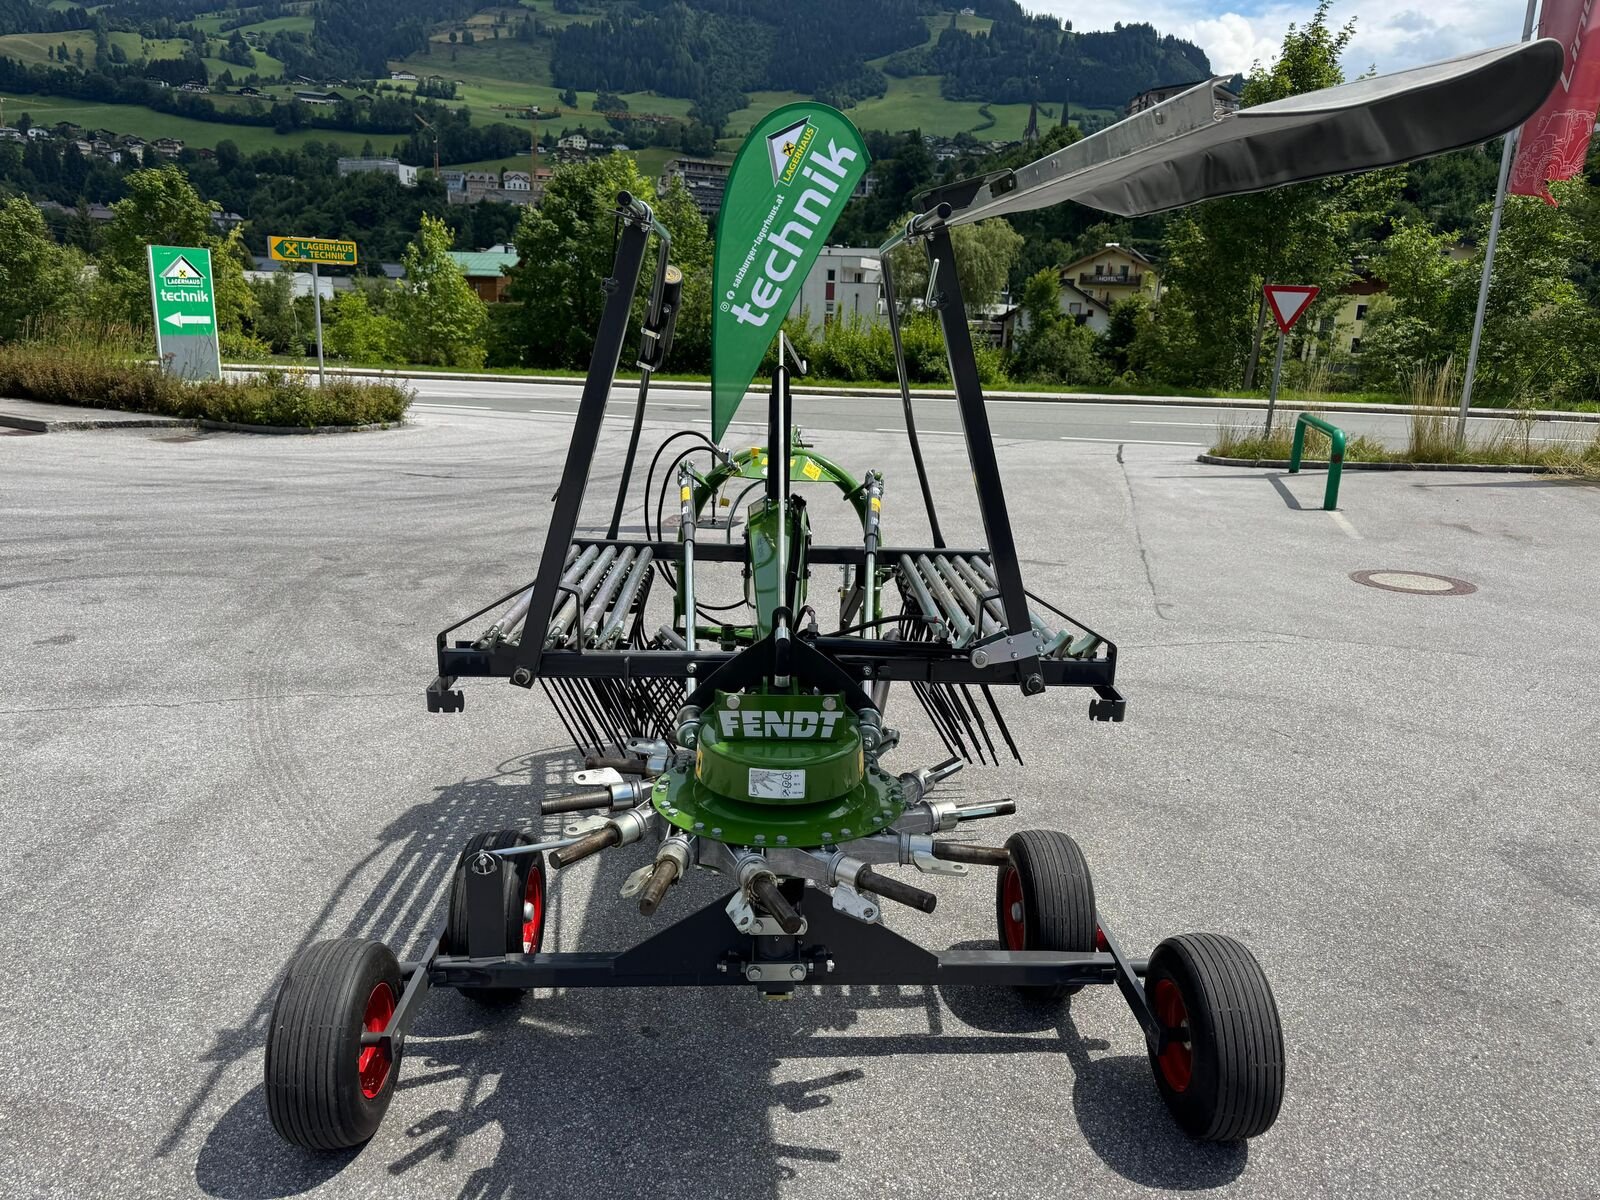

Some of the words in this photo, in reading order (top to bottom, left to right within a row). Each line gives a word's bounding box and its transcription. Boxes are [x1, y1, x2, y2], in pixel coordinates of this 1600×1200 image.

[783, 127, 815, 182] LAGERHAUS
[730, 137, 858, 327] technik
[732, 193, 785, 288] salzburger-lagerhaus.at
[301, 242, 353, 253] LAGERHAUS
[309, 251, 346, 260] TECHNIK
[160, 289, 209, 303] technik
[718, 710, 844, 738] FENDT
